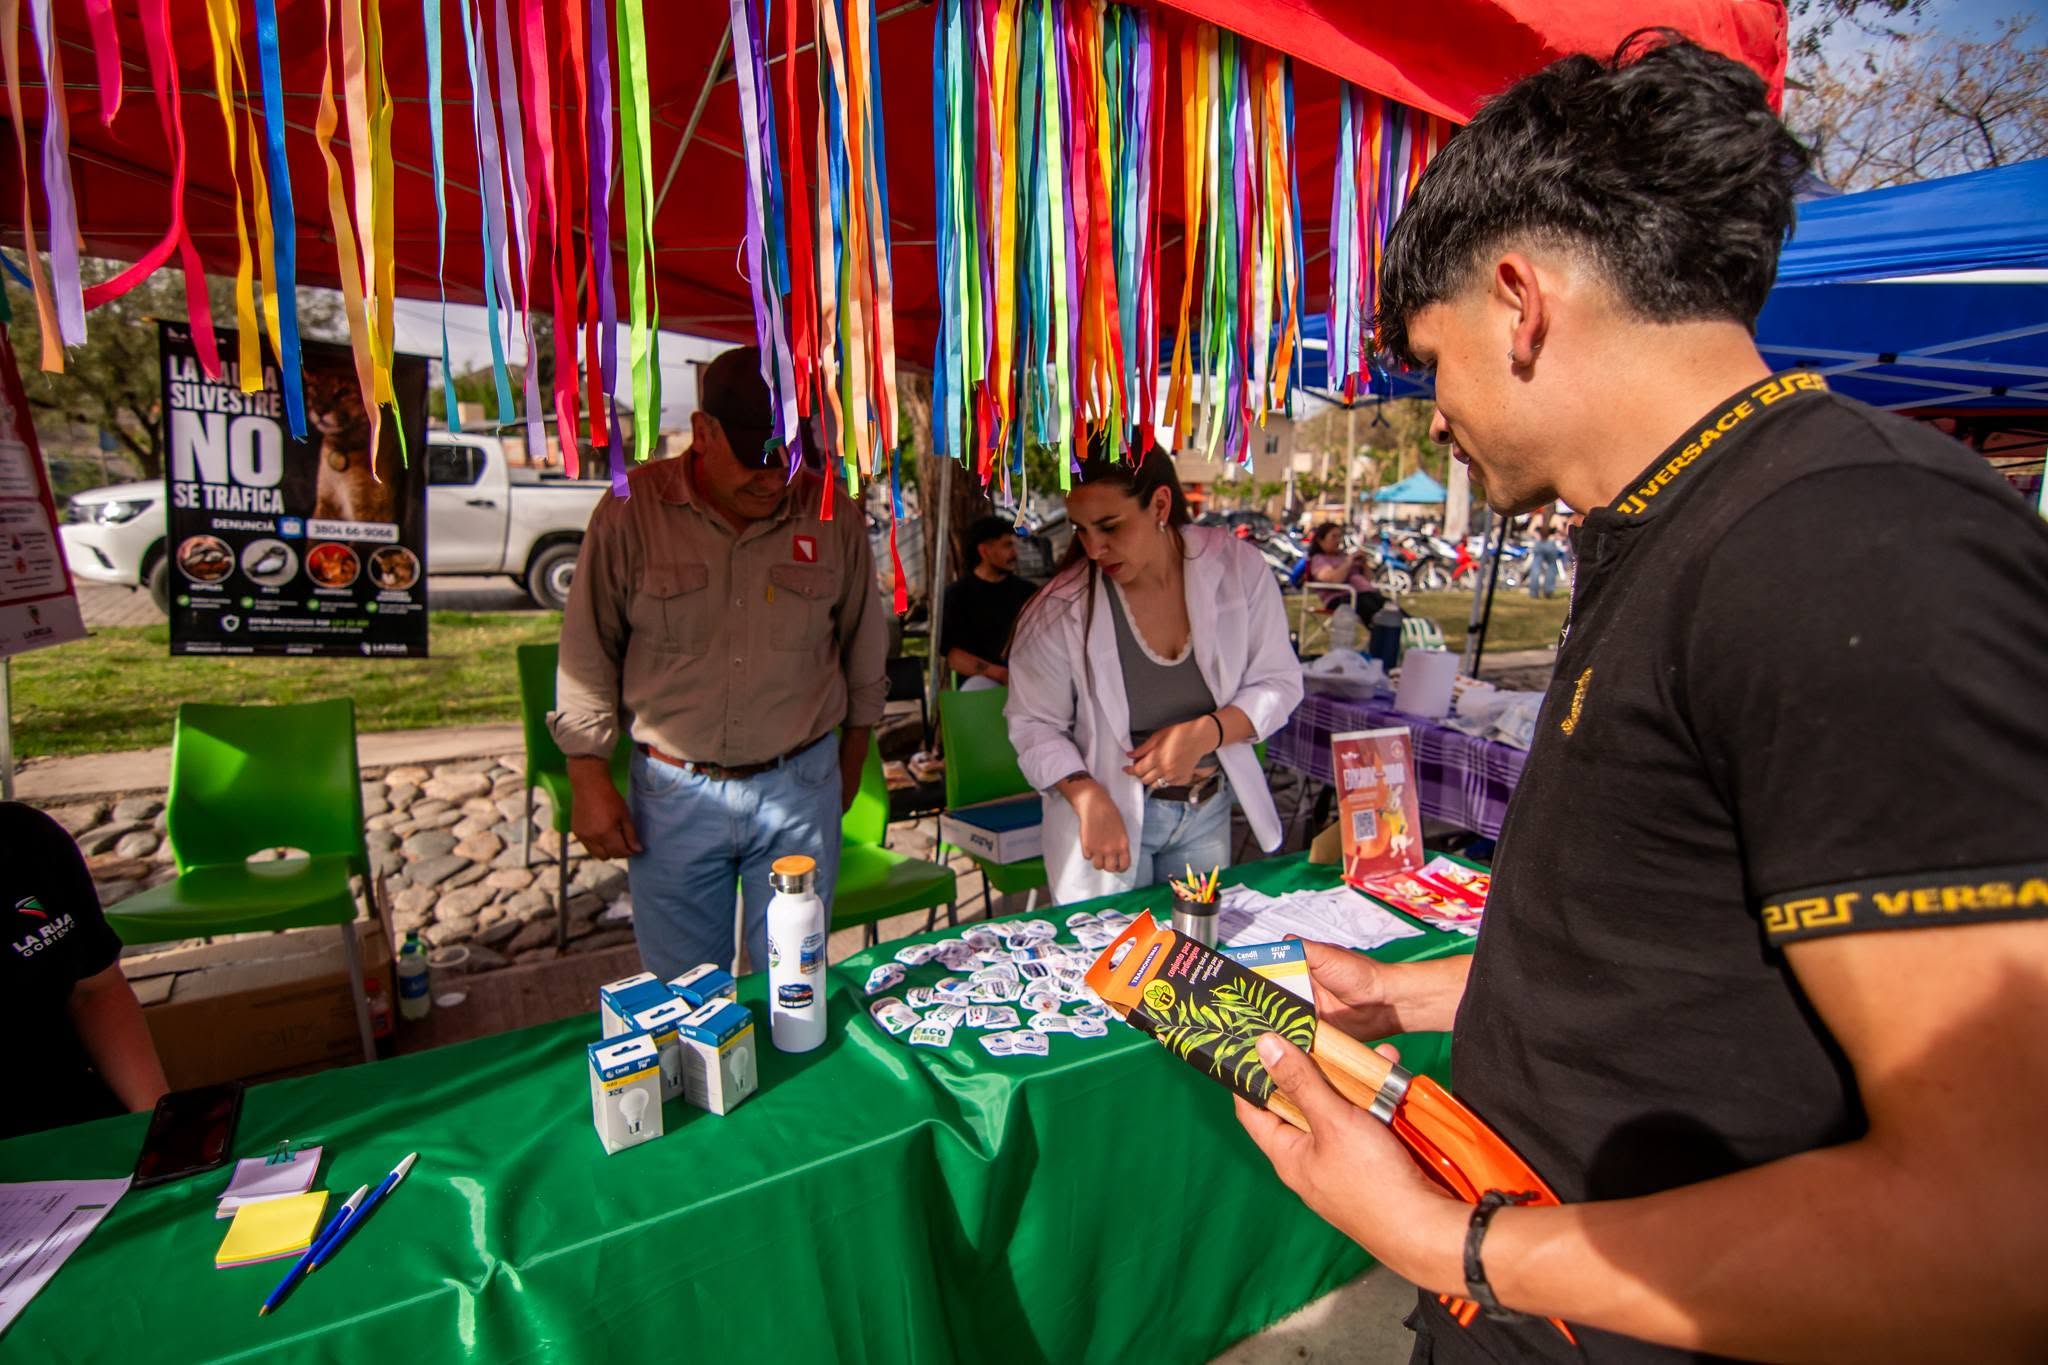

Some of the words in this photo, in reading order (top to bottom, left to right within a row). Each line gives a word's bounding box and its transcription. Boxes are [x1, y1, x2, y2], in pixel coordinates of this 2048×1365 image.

[169, 355, 199, 382] LA
[204, 359, 279, 391] AUA
[171, 382, 282, 417] SILVESTRE
[171, 410, 284, 488] NO
[1639, 400, 1755, 497] VERSACE
[173, 483, 202, 508] SE
[203, 485, 285, 514] TRAFICA
[12, 934, 40, 952] LA
[1167, 953, 1185, 978] conjunto
[1181, 941, 1192, 955] para
[1272, 951, 1286, 960] 7W
[1131, 945, 1160, 984] TRAMONTINA
[1178, 946, 1200, 978] jardinagem
[922, 1027, 946, 1037] ECO
